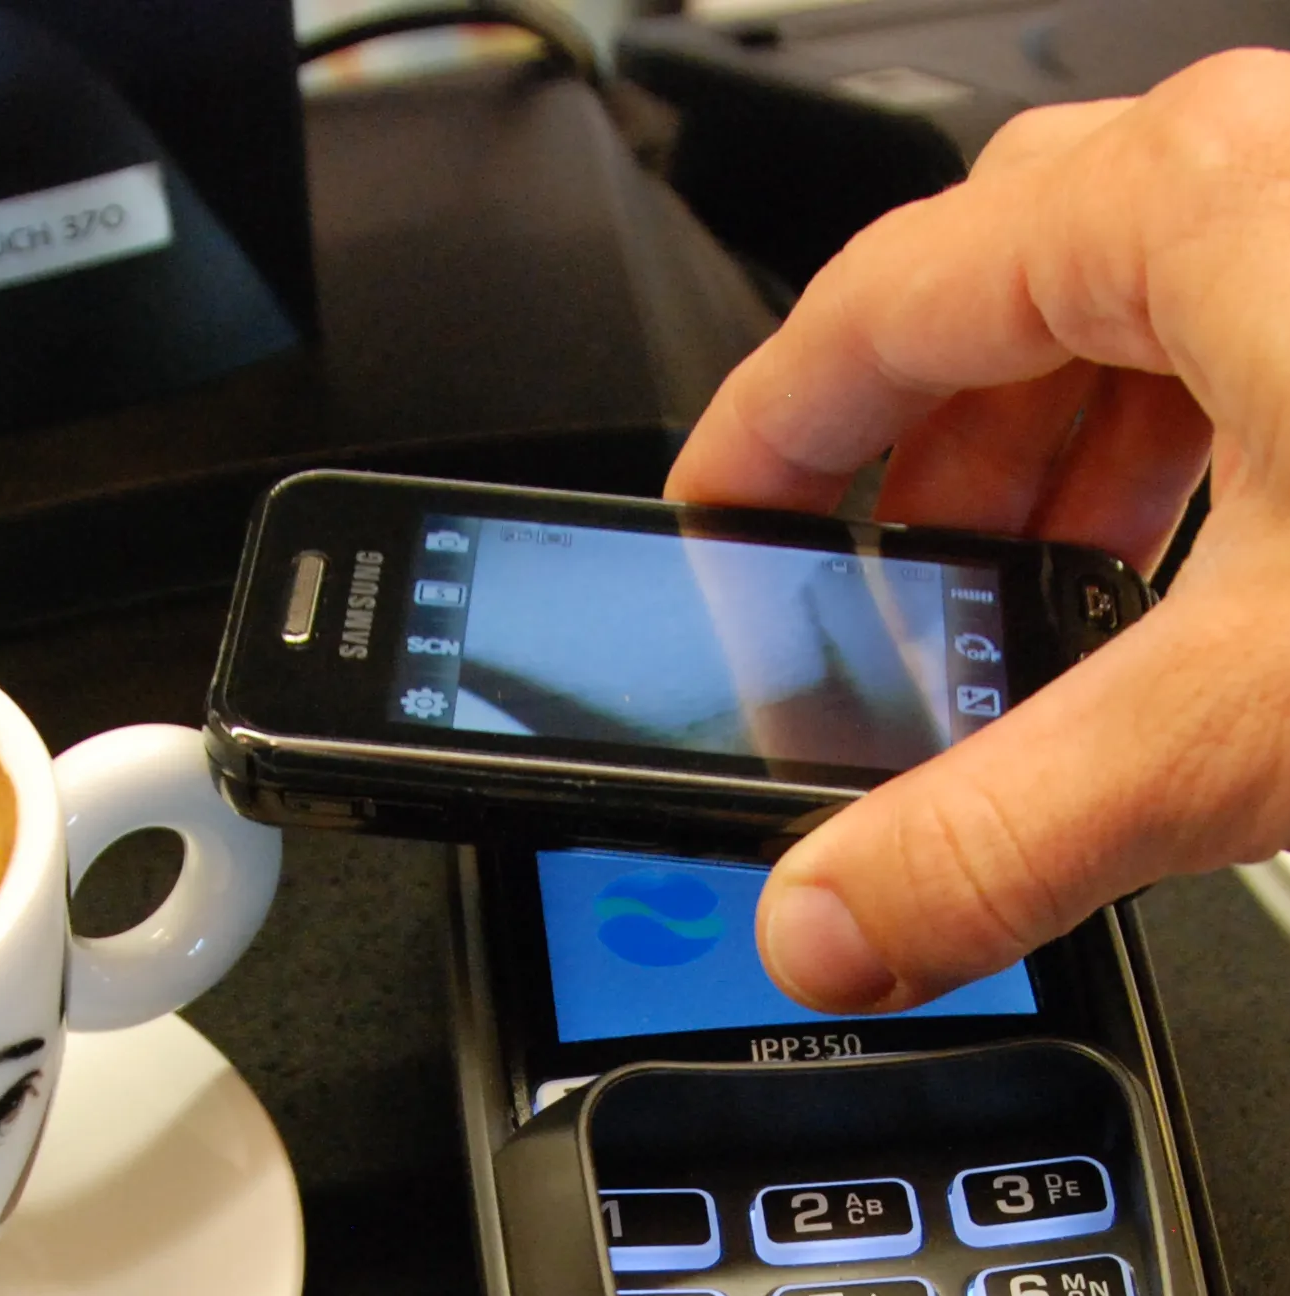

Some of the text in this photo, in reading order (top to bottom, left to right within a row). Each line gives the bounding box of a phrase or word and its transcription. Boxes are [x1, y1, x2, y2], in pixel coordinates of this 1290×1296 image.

[62, 202, 126, 242] 370
[338, 550, 384, 660] SAMSUNG
[790, 1192, 833, 1233] 2
[992, 1175, 1035, 1214] 3
